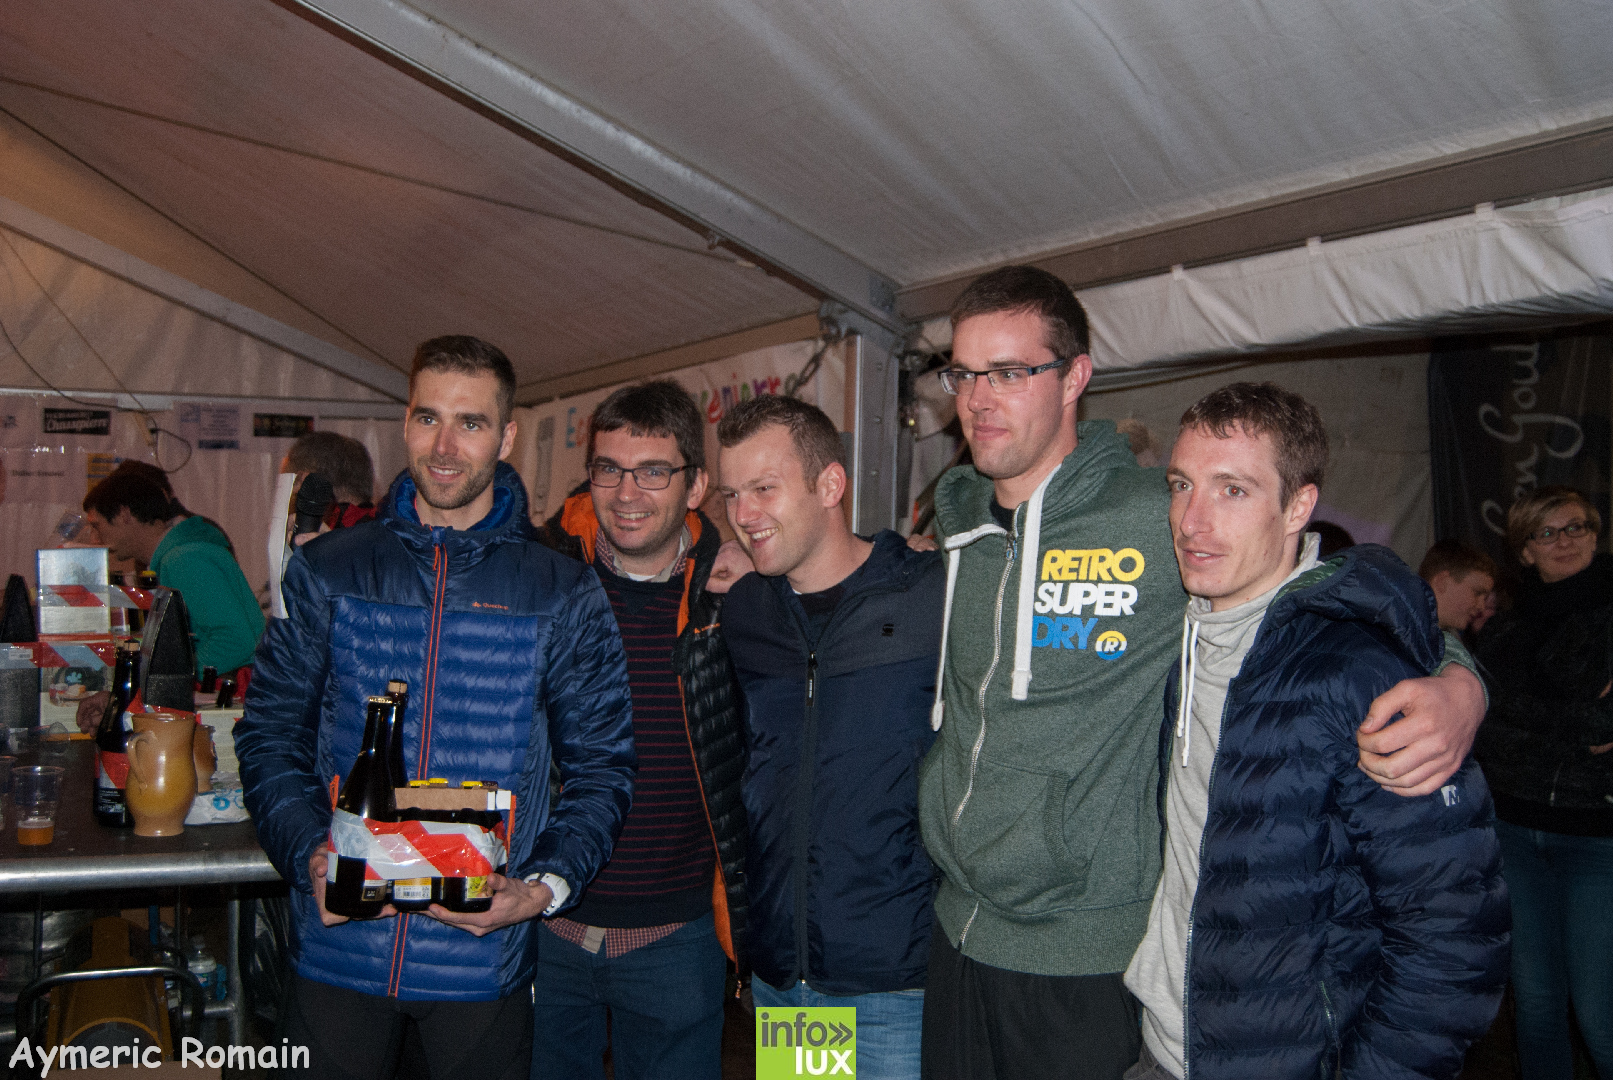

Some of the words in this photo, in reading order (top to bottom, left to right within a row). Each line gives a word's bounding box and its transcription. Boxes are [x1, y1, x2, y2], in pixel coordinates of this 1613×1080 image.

[1041, 547, 1146, 582] RETRO
[1034, 582, 1138, 616] SUPER
[1031, 615, 1099, 650] DRY
